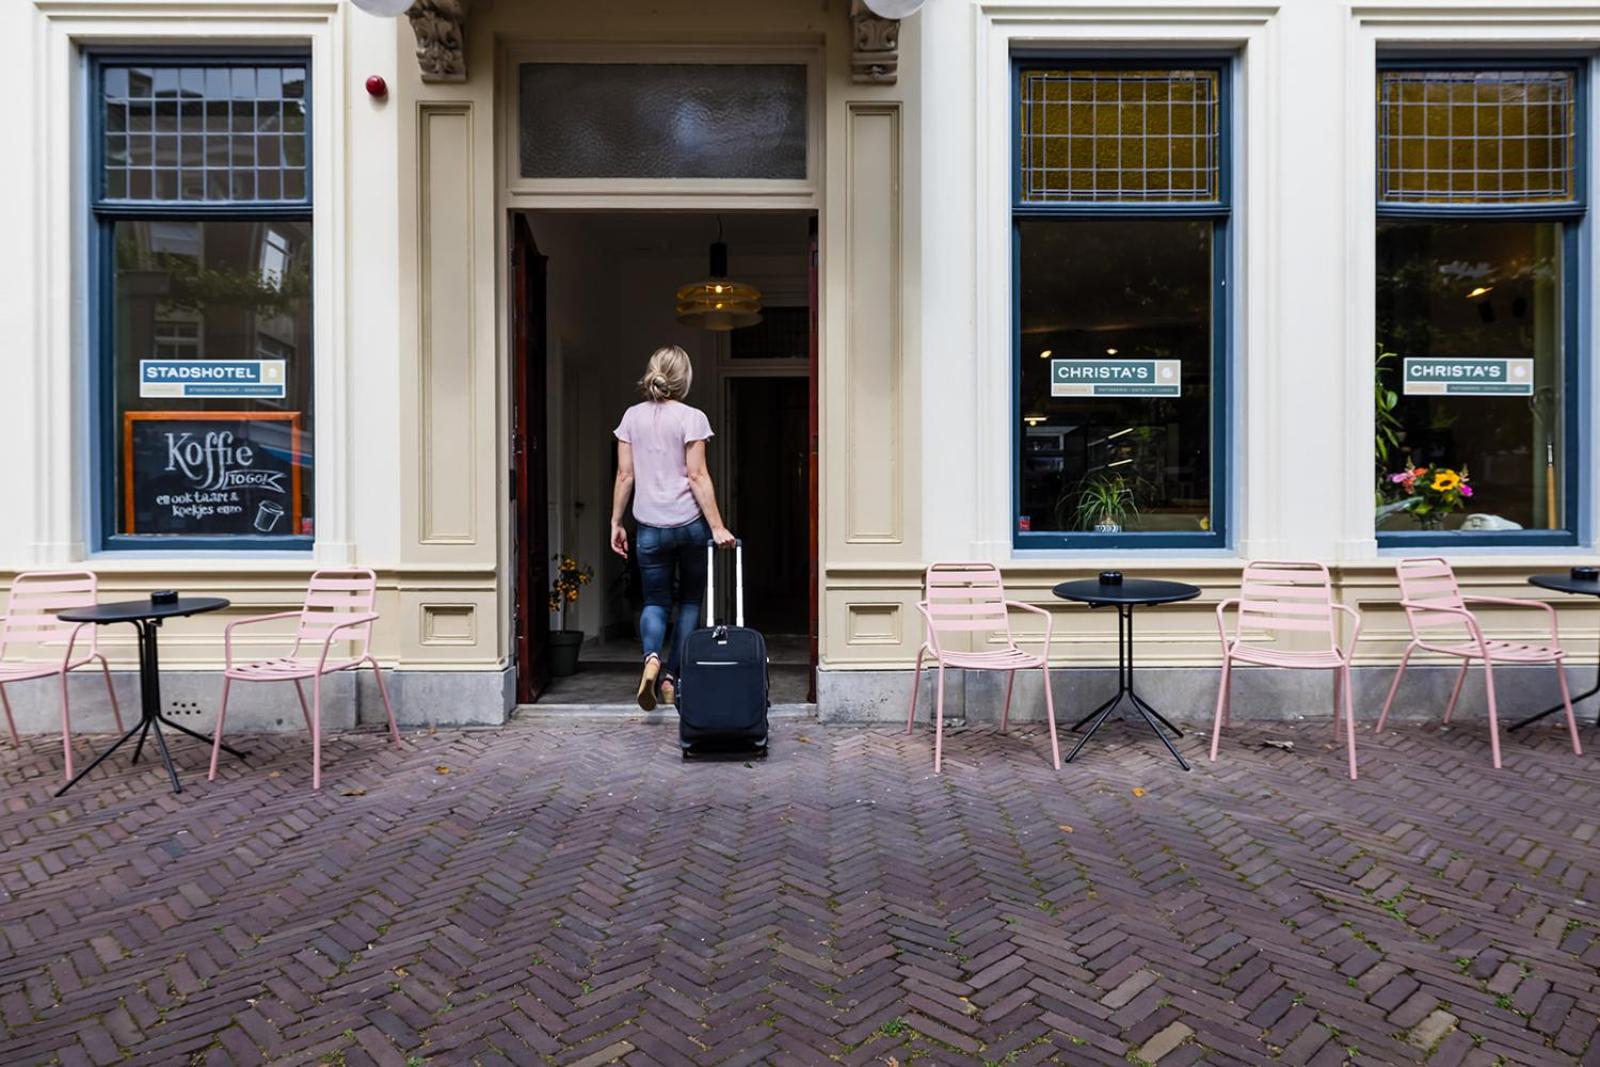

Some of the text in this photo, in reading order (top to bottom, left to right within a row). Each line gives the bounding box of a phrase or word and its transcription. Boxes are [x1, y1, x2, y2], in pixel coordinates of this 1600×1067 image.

[146, 367, 256, 378] STADSHOTEL
[1058, 366, 1148, 379] CHRISTA'S
[1410, 365, 1501, 377] CHRISTA'S
[164, 431, 253, 490] Koffie
[171, 492, 193, 504] ook
[194, 491, 228, 503] taart
